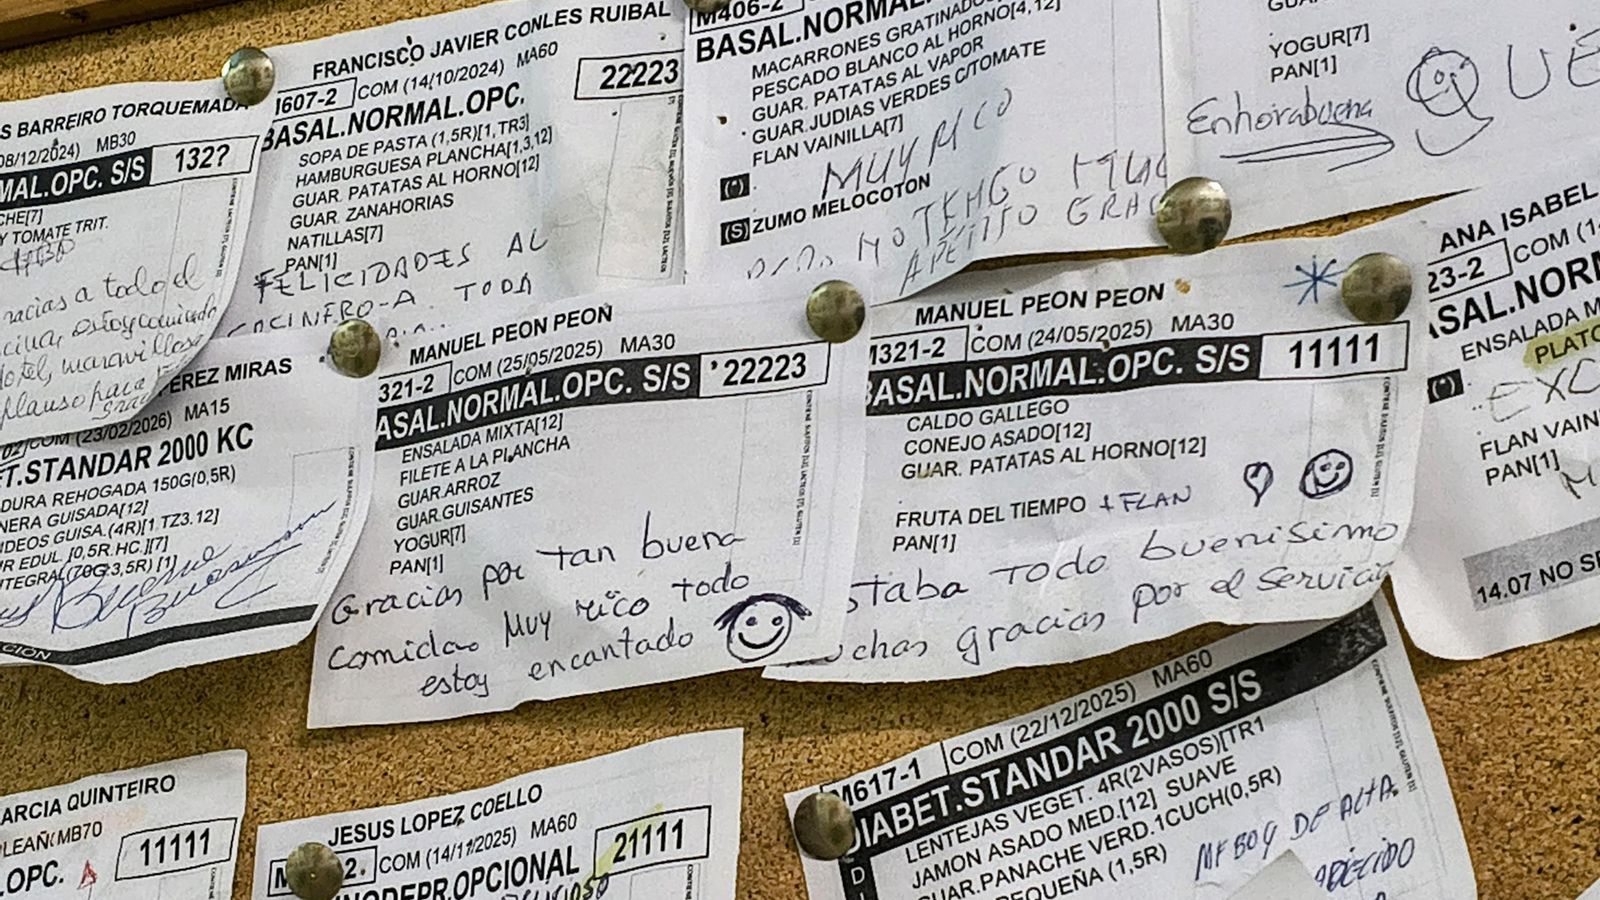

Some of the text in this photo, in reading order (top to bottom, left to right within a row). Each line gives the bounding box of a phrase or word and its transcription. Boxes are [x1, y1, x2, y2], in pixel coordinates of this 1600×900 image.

[313, 1, 671, 80] FRANCISCO JAVIER CONLES RUIBAL
[752, 33, 881, 79] MACARRONES
[1269, 23, 1370, 58] YOGUR[7]
[358, 41, 558, 101] COM (14/10/2024) MA60
[600, 59, 679, 90] 22223
[752, 66, 840, 101] PESCADO
[845, 42, 918, 77] BLANCO
[923, 34, 945, 53] AL
[752, 36, 984, 122] GUAR. PATATAS AL VAPOR
[881, 40, 1047, 111] VERDES C/TOMATE
[1271, 55, 1337, 82] PAN[1]
[17, 97, 249, 138] BARREIRO TORQUEMADA
[1187, 86, 1373, 136] Enhorabuena
[96, 131, 136, 152] MB30
[176, 144, 230, 173] 132?
[299, 135, 427, 167] SOPA DE PASTA
[752, 114, 904, 167] FLAN VAINILLA[7]
[111, 155, 145, 186] S/S
[296, 156, 422, 188] HAMBURGUESA
[349, 175, 422, 200] PATATAS
[426, 170, 448, 187] AL
[453, 154, 540, 184] HORNO[12]
[346, 193, 454, 222] ZANAHORIAS
[752, 173, 931, 234] ZUMO MELOCOTON
[1440, 182, 1599, 253] ANA ISABEL
[13, 216, 108, 245] TOMATE TRIT.
[287, 225, 383, 251] NATILLAS[7]
[1513, 229, 1570, 263] COM
[285, 253, 337, 273] PAN[1]
[915, 284, 1165, 326] MANUEL PEON PEON
[410, 331, 486, 366] MANUEL
[492, 318, 548, 346] PEON
[554, 305, 614, 335] PEON
[971, 313, 1235, 354] COM (24/05/2025) MA30
[1289, 333, 1380, 369] 11111
[1461, 307, 1580, 361] ENSALADA
[225, 358, 292, 384] MIRAS
[454, 362, 492, 385] COM
[497, 341, 603, 377] (25/05/2025)
[620, 333, 675, 353] MA30
[642, 361, 690, 392] S/S
[722, 352, 806, 386] 22223
[1196, 344, 1250, 374] S/S
[184, 398, 230, 423] MA15
[907, 399, 1070, 433] CALDO GALLEGO
[158, 423, 254, 467] 2000 KC
[402, 413, 564, 465] ENSALADA MIXTA[12]
[901, 437, 1207, 480] GUAR. PATATAS AL HORNO[12]
[903, 422, 1092, 456] CONEJO ASADO[12]
[1480, 428, 1538, 460] FLAN
[400, 435, 571, 487] FILETE A LA PLANCHA
[1485, 449, 1560, 486] PAN[1]
[52, 481, 147, 507] REHOGADA
[153, 465, 236, 493] 150G(0,5R)
[47, 500, 149, 528] GUISADA[12]
[896, 496, 1087, 529] FRUTA DEL TIEMPO
[394, 524, 466, 553] YOGUR[7]
[893, 532, 957, 553] PAN[1]
[389, 553, 444, 576] PAN[1]
[672, 563, 749, 603] todo
[1477, 560, 1573, 603] 14.07 NO
[332, 585, 462, 625] Gracias
[482, 564, 525, 601] por
[957, 609, 1105, 666] gracias
[1132, 580, 1190, 623] por
[419, 617, 694, 698] estoy encantado
[950, 736, 1004, 766] COM
[1011, 682, 1136, 749] (22/12/2025)
[1152, 650, 1213, 688] MA60
[1126, 668, 1264, 749] 2000 S/S
[68, 774, 176, 810] QUINTEIRO
[57, 821, 103, 845] MB70
[328, 783, 543, 847] JESUS LOPEZ COELLO
[906, 814, 1010, 863] LENTEJAS
[1013, 786, 1093, 823] VEGET.
[911, 855, 982, 890] JAMON
[988, 825, 1063, 862] ASADO
[1068, 790, 1157, 832] MED.[12]
[1166, 755, 1237, 798] SUAVE
[140, 828, 210, 867] 11111
[379, 850, 421, 874] COM
[531, 812, 577, 838] MA60
[612, 818, 684, 864] 21111
[1108, 843, 1167, 882] (1,5R)
